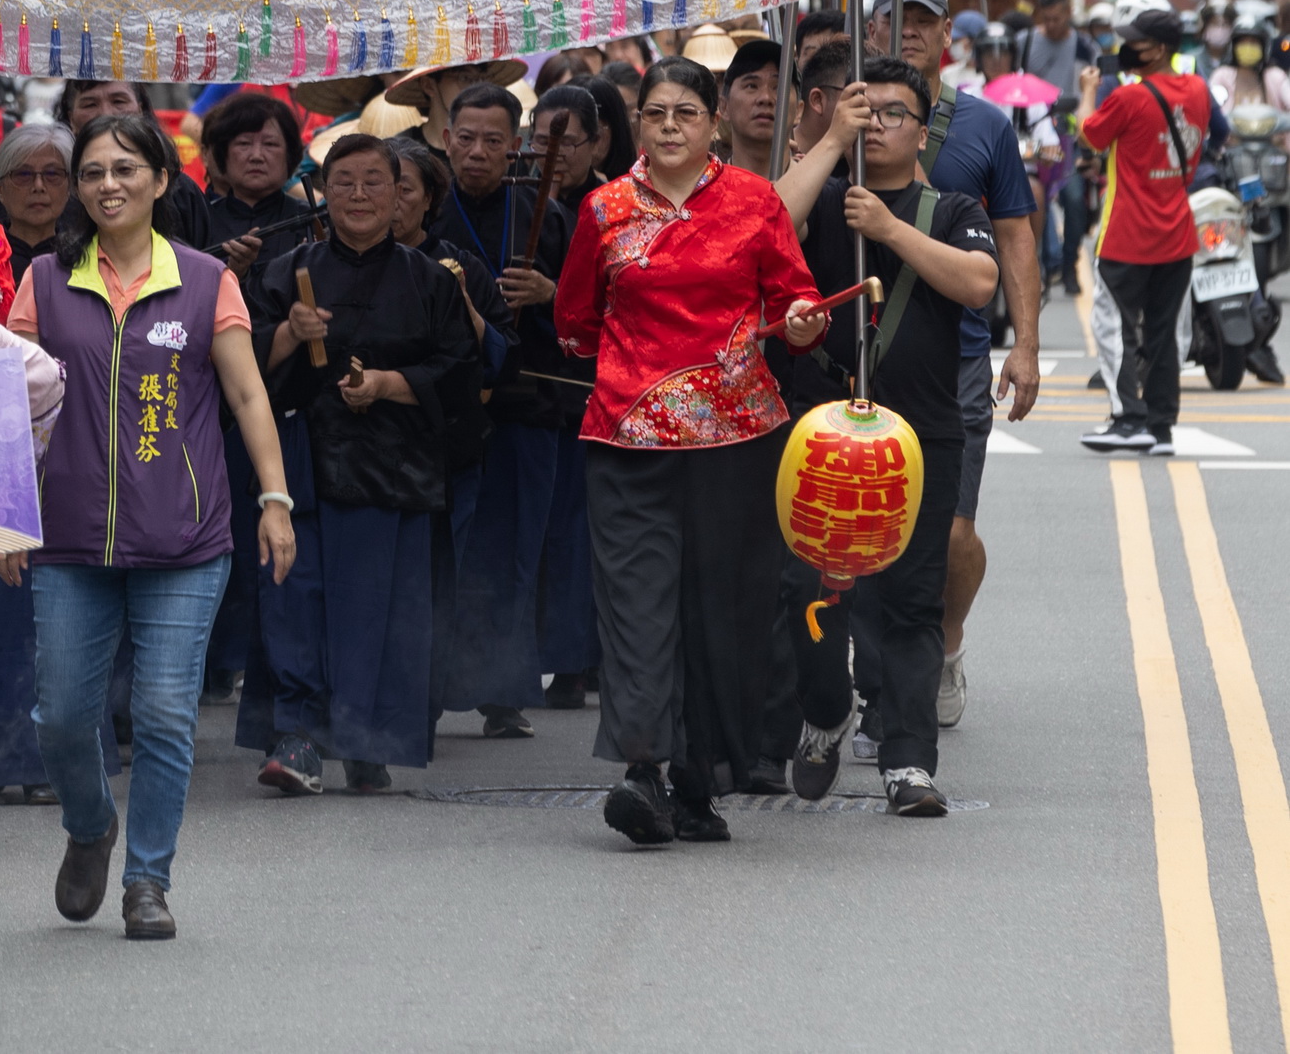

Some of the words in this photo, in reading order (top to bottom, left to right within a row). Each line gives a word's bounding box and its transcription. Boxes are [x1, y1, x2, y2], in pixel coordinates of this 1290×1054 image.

[136, 374, 164, 462] 張雀芬
[165, 353, 181, 429] 文化局長
